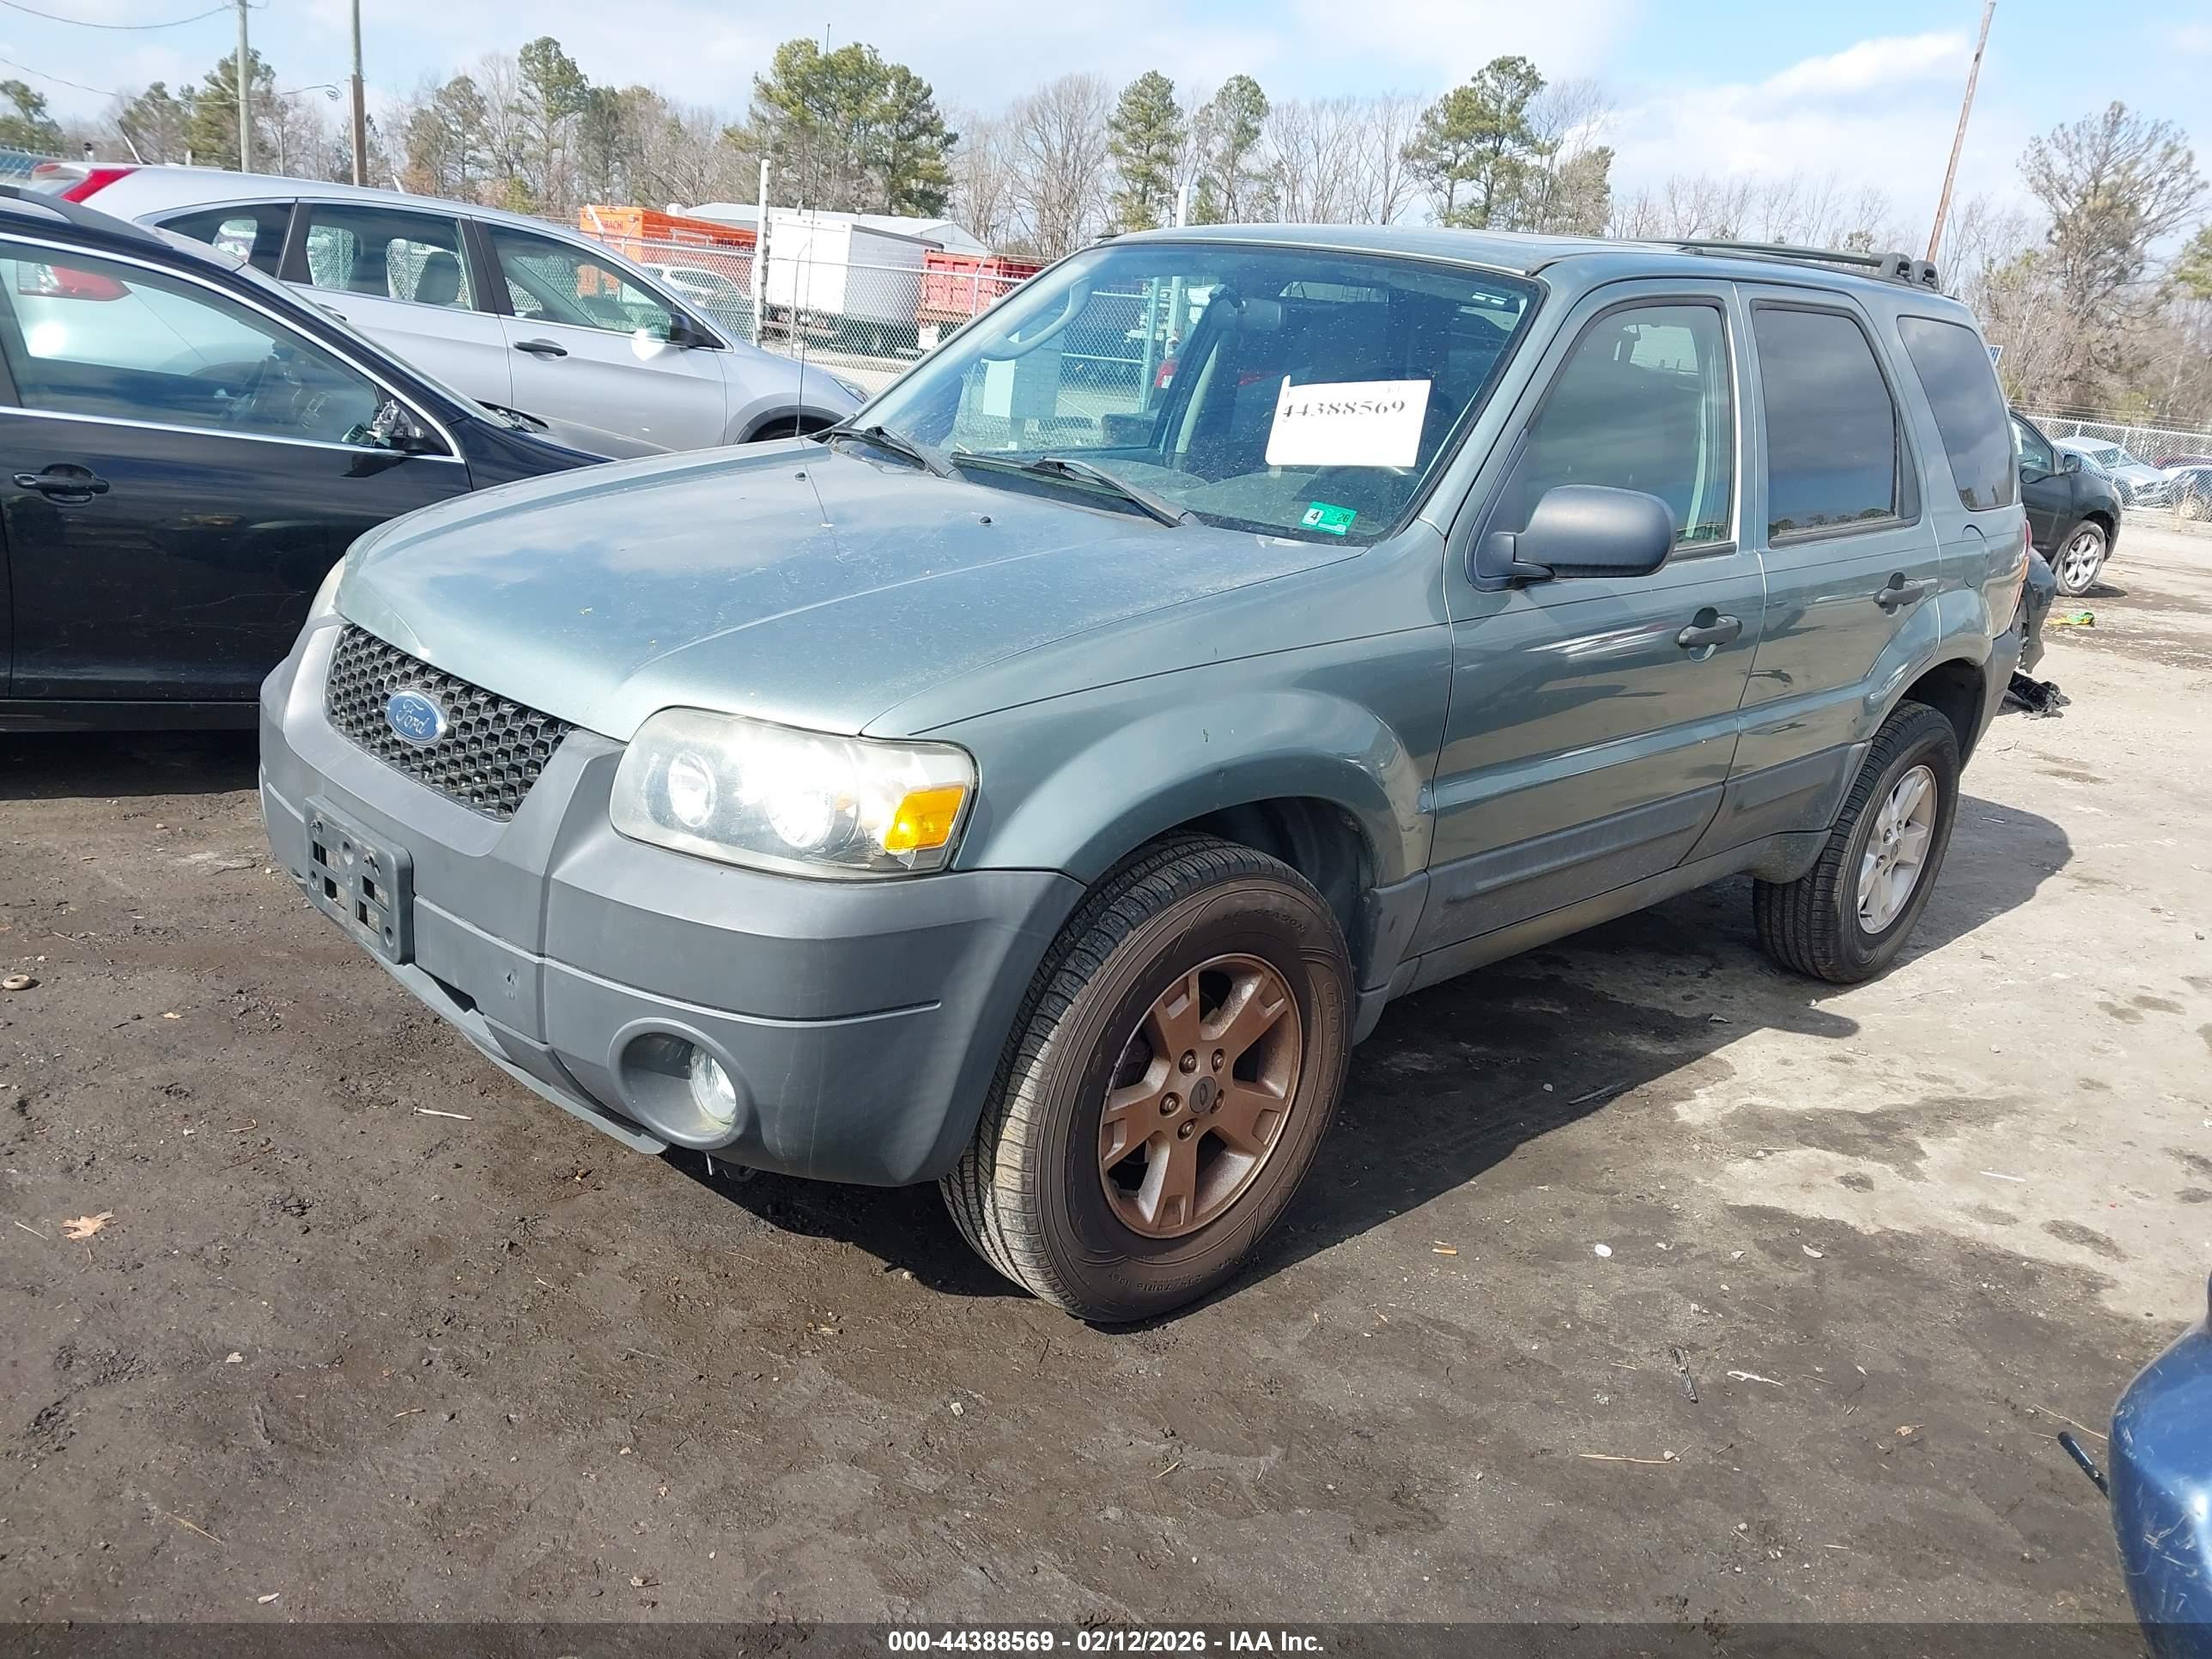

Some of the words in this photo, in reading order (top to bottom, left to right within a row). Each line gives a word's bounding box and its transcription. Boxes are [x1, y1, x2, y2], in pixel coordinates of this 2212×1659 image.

[716, 238, 757, 248] HIBACH
[1283, 399, 1406, 418] 44388569
[1310, 510, 1321, 521] 4
[396, 699, 430, 735] Ford
